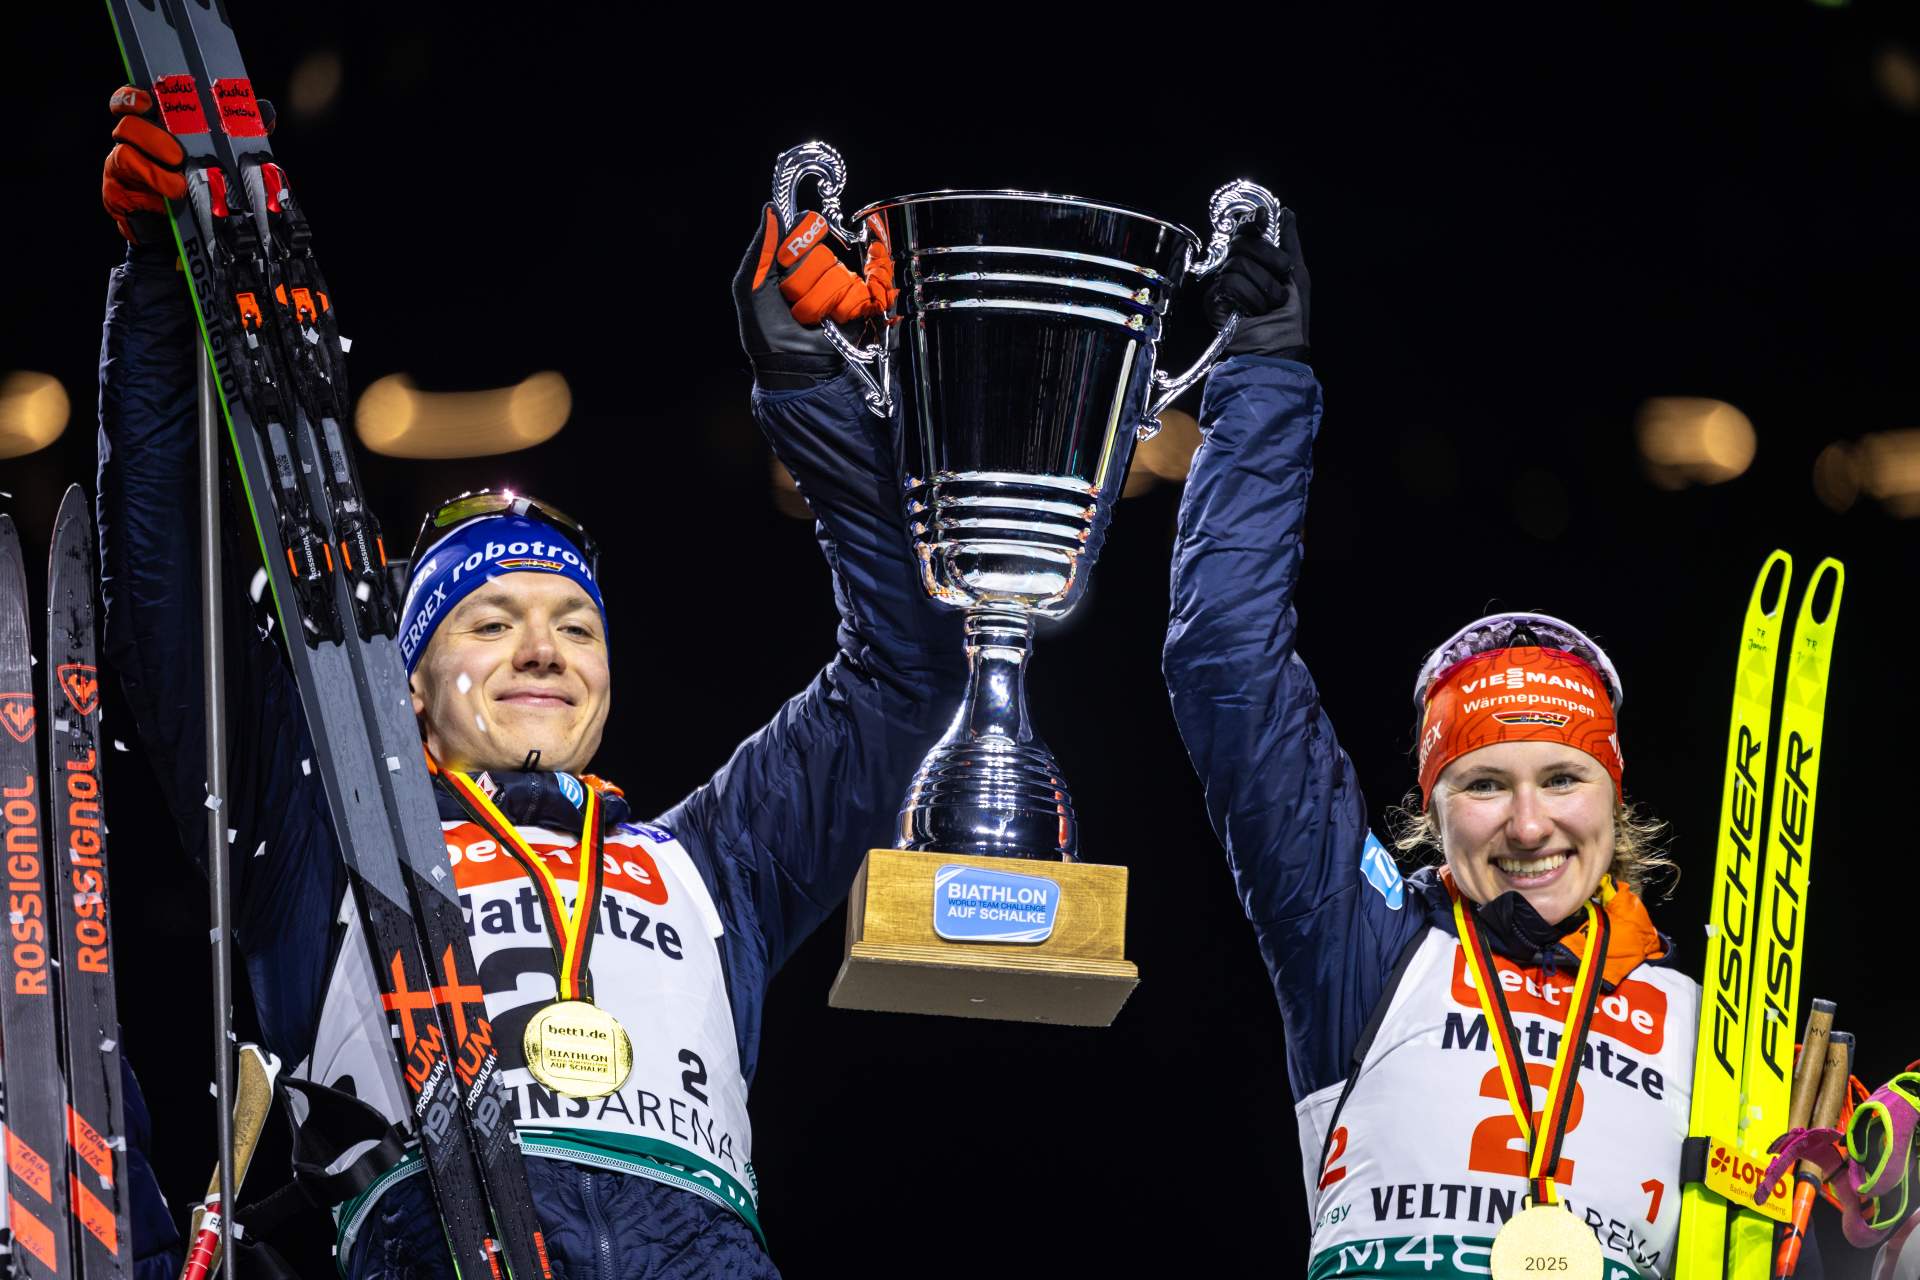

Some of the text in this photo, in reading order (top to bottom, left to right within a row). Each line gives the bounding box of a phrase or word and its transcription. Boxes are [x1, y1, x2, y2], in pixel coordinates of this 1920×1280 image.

[452, 539, 593, 584] robotron
[401, 581, 447, 663] ERREX
[1461, 667, 1596, 700] VIESSMANN
[1463, 692, 1595, 718] Wärmepumpen
[66, 748, 109, 974] ROSSIGNOL
[3, 774, 48, 995] ROSSIGNOL
[947, 883, 1048, 905] BIATHLON
[948, 899, 1046, 912] WORLD TEAM CHALLENGE
[1713, 725, 1762, 1081] FISCHER
[947, 906, 1046, 924] AUF SCHALKE
[1761, 731, 1814, 1083] FISCHER
[548, 1024, 607, 1040] bett1.de
[549, 1049, 608, 1063] BIATHLON
[550, 1061, 566, 1069] AUF
[569, 1061, 609, 1073] SCHALKE
[678, 1048, 709, 1106] 2
[1468, 1063, 1584, 1185] 2
[1319, 1126, 1348, 1191] 2
[1732, 1155, 1787, 1199] LOTO
[1371, 1183, 1531, 1225] VELTIN
[1641, 1178, 1665, 1225] 1
[1524, 1256, 1569, 1271] 2025
